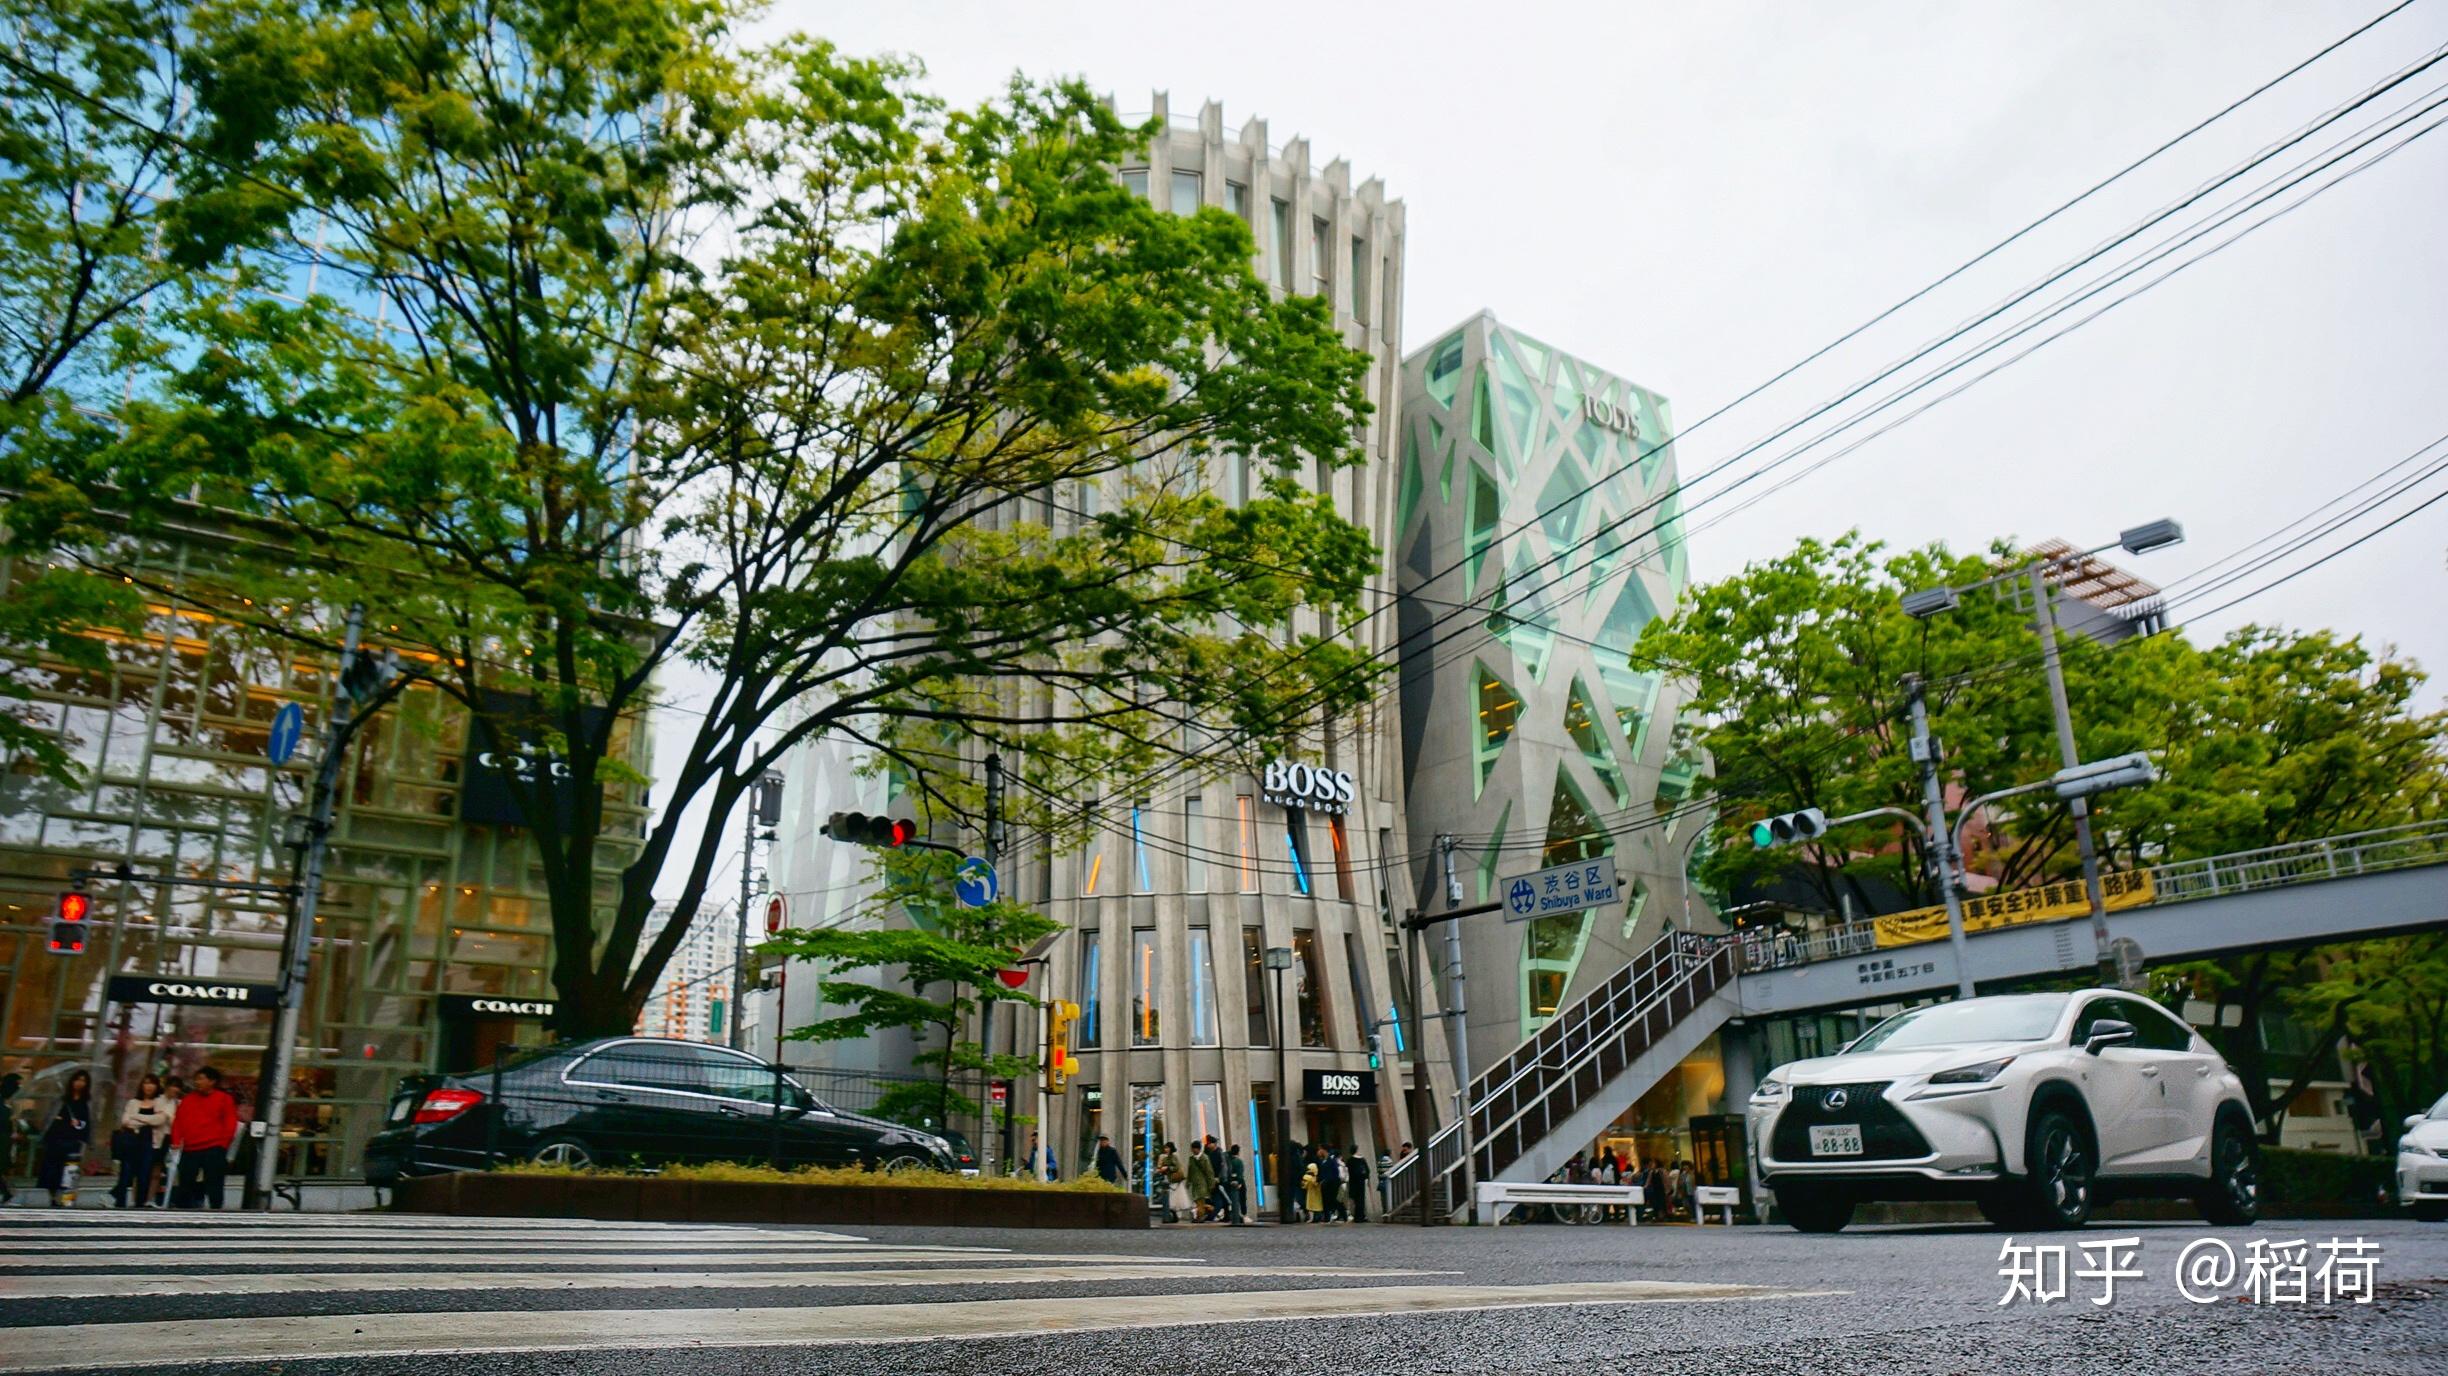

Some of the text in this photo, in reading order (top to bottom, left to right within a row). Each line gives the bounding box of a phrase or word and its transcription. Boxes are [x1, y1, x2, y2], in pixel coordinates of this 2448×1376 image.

[1264, 757, 1355, 803] BOSS
[1314, 801, 1353, 816] BOSS
[1544, 866, 1602, 894] 渋谷区
[1541, 886, 1612, 910] Shibuya Ward
[148, 983, 248, 1001] COACH
[472, 999, 553, 1015] COACH
[1322, 1074, 1360, 1090] BOSS
[1823, 1137, 1860, 1152] 88-88
